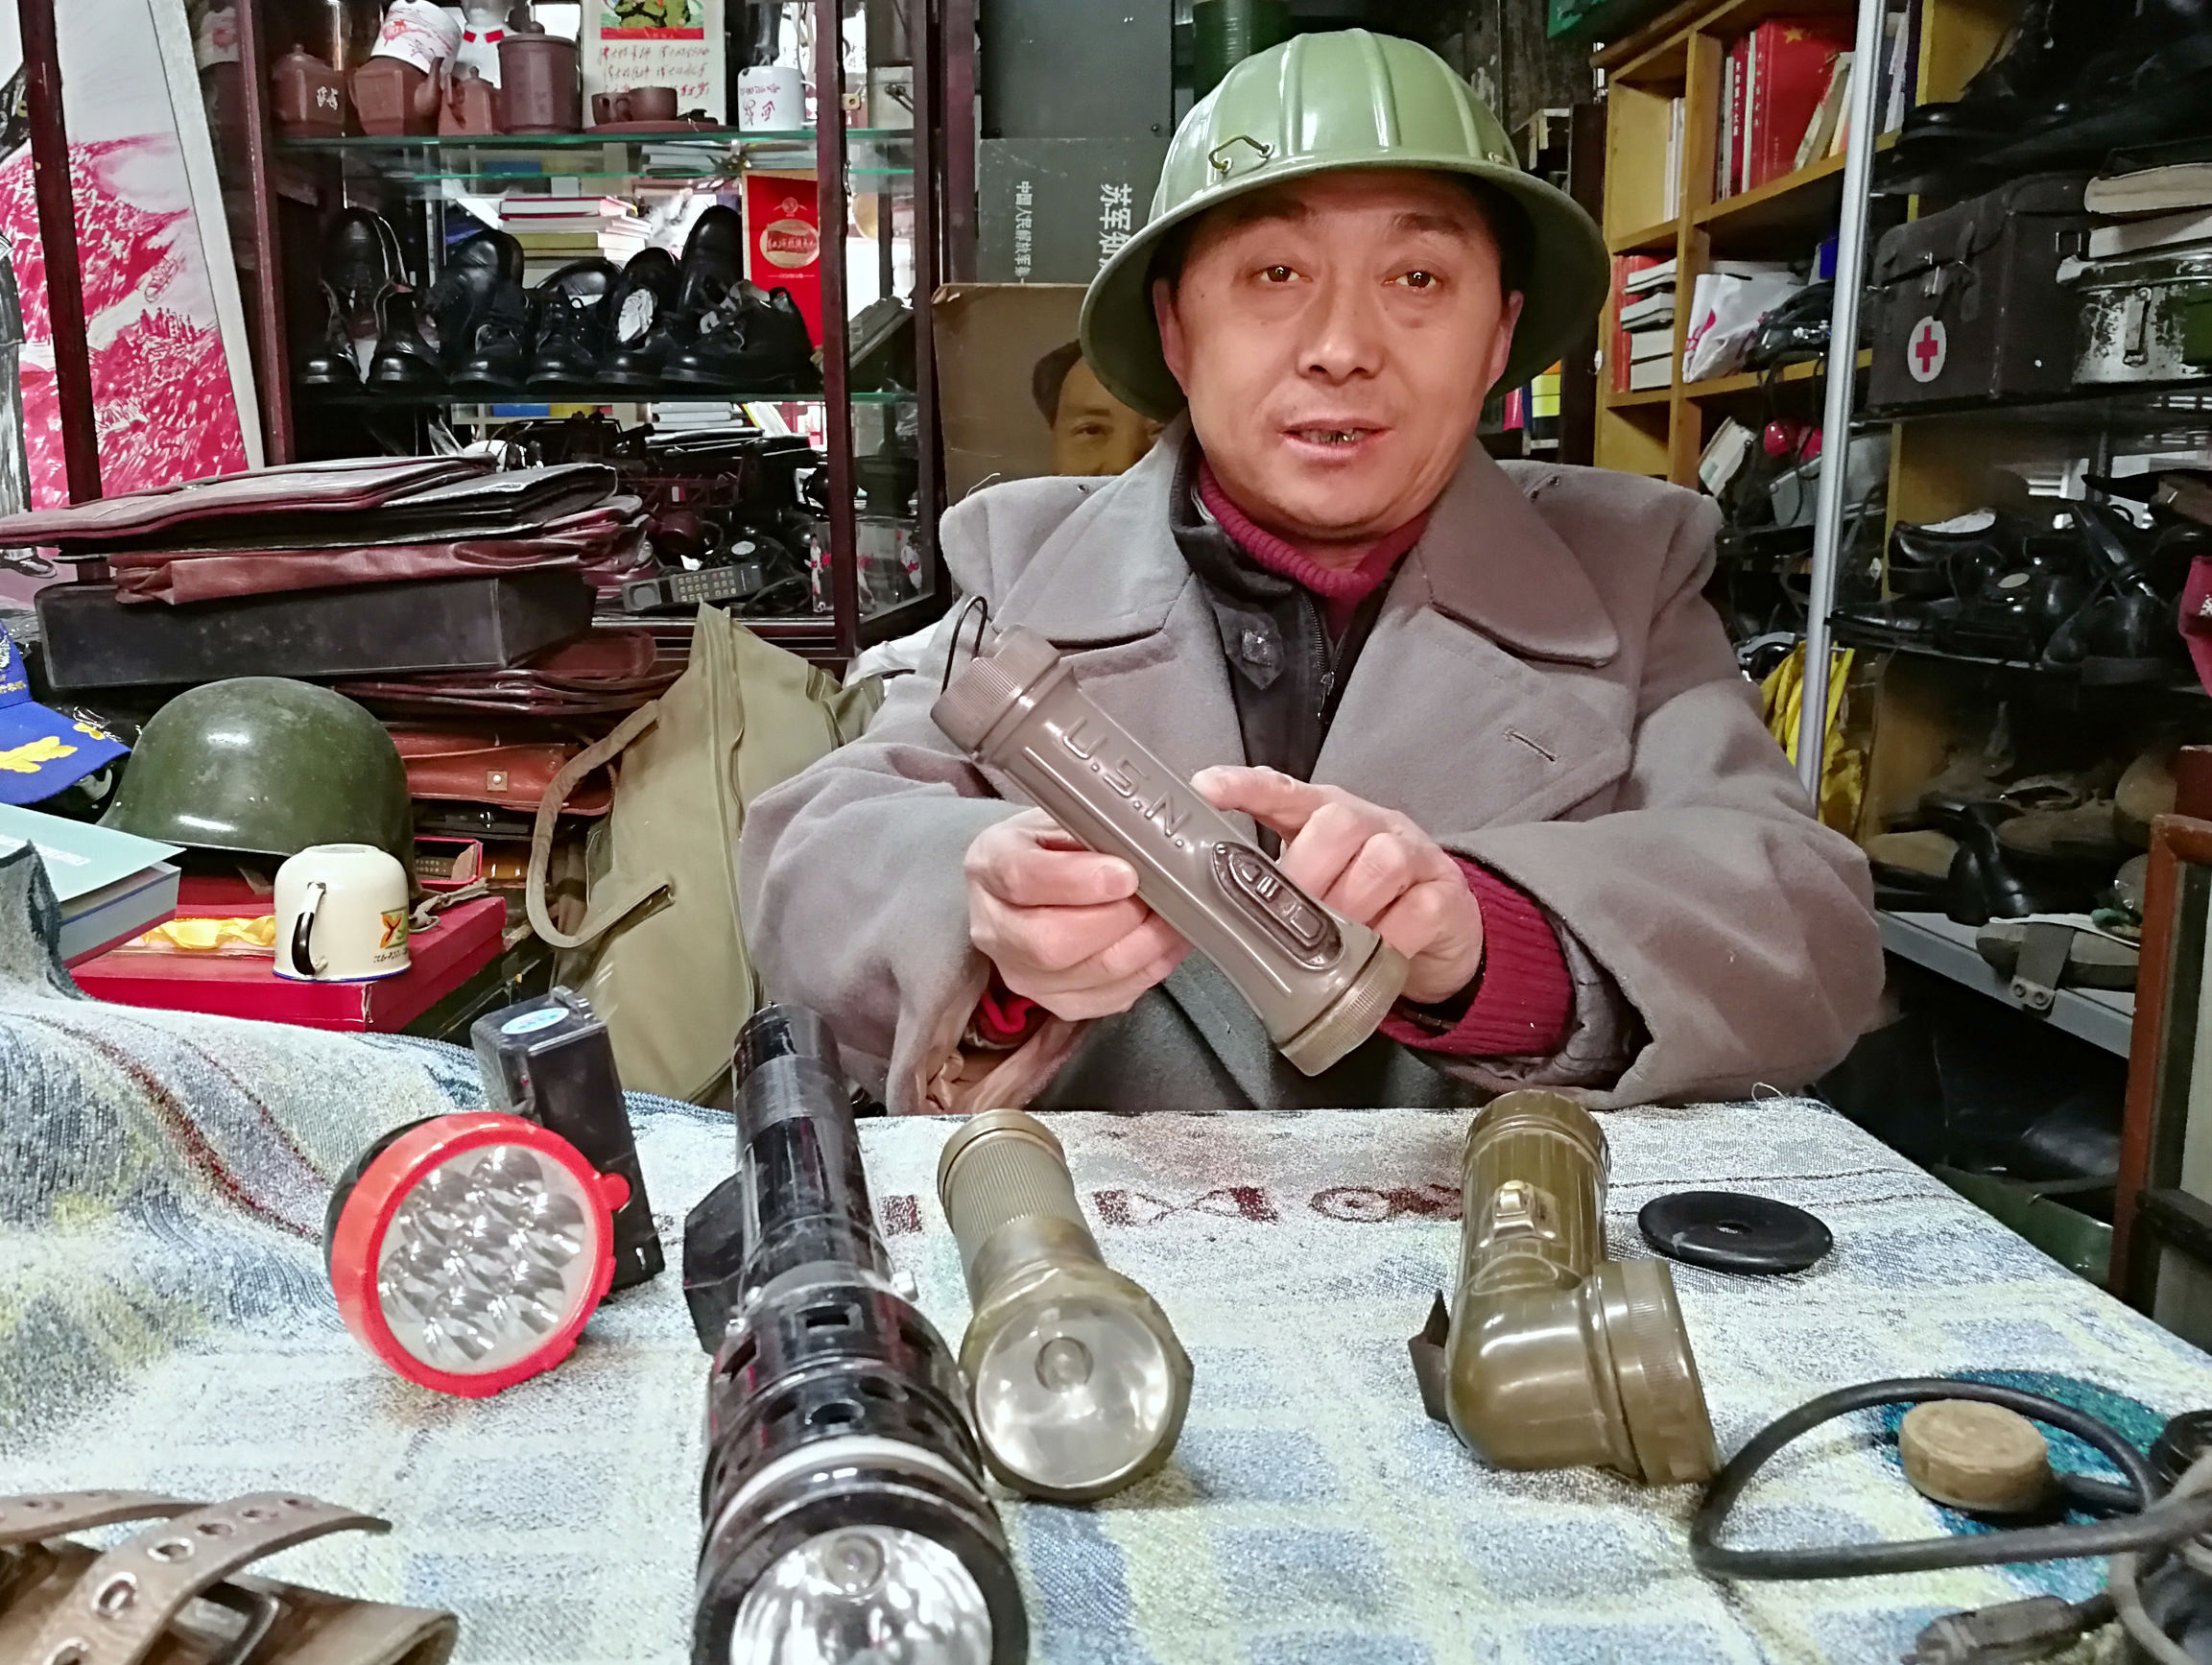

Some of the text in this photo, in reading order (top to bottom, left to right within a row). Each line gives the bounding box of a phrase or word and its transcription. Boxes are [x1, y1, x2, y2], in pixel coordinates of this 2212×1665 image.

[1098, 182, 1133, 272] 苏军知
[1062, 716, 1192, 848] U.S.N.
